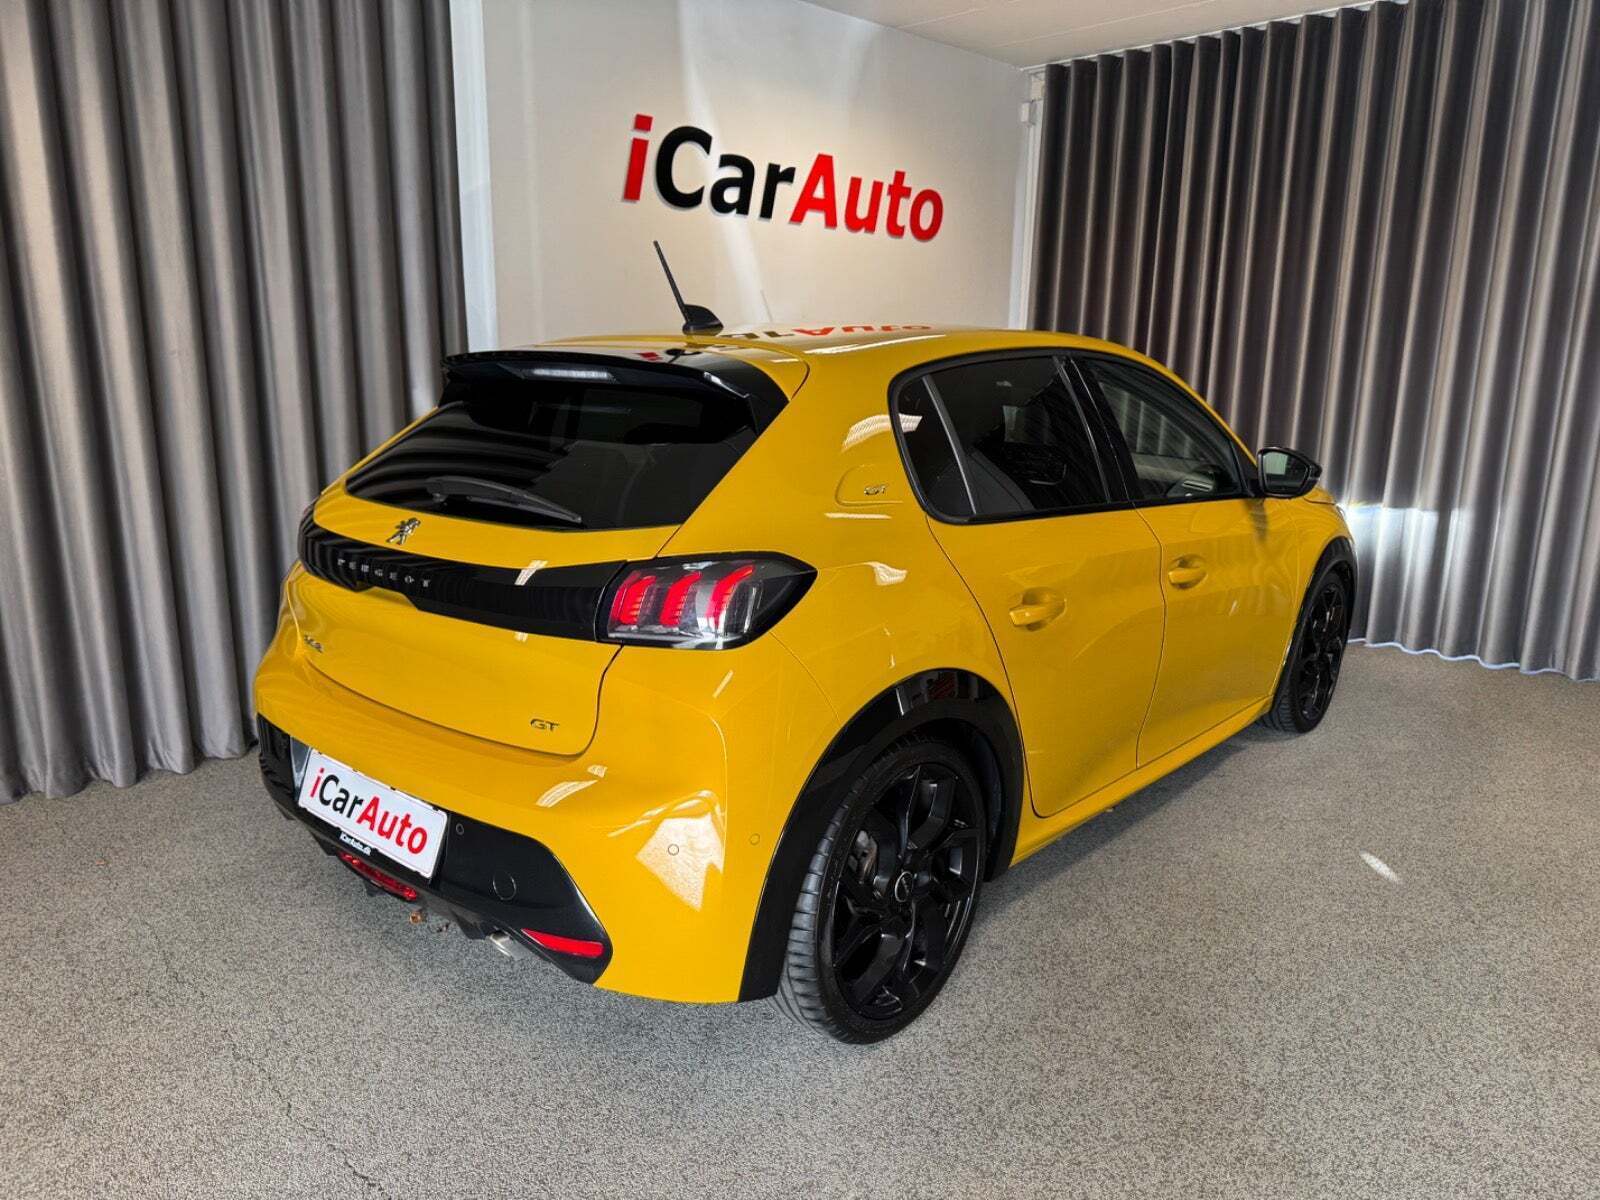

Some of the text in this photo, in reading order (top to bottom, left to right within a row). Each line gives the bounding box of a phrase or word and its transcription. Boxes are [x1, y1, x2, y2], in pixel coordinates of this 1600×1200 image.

[622, 113, 944, 242] iCarAuto
[530, 718, 560, 732] GT
[309, 767, 428, 855] iCarAuto
